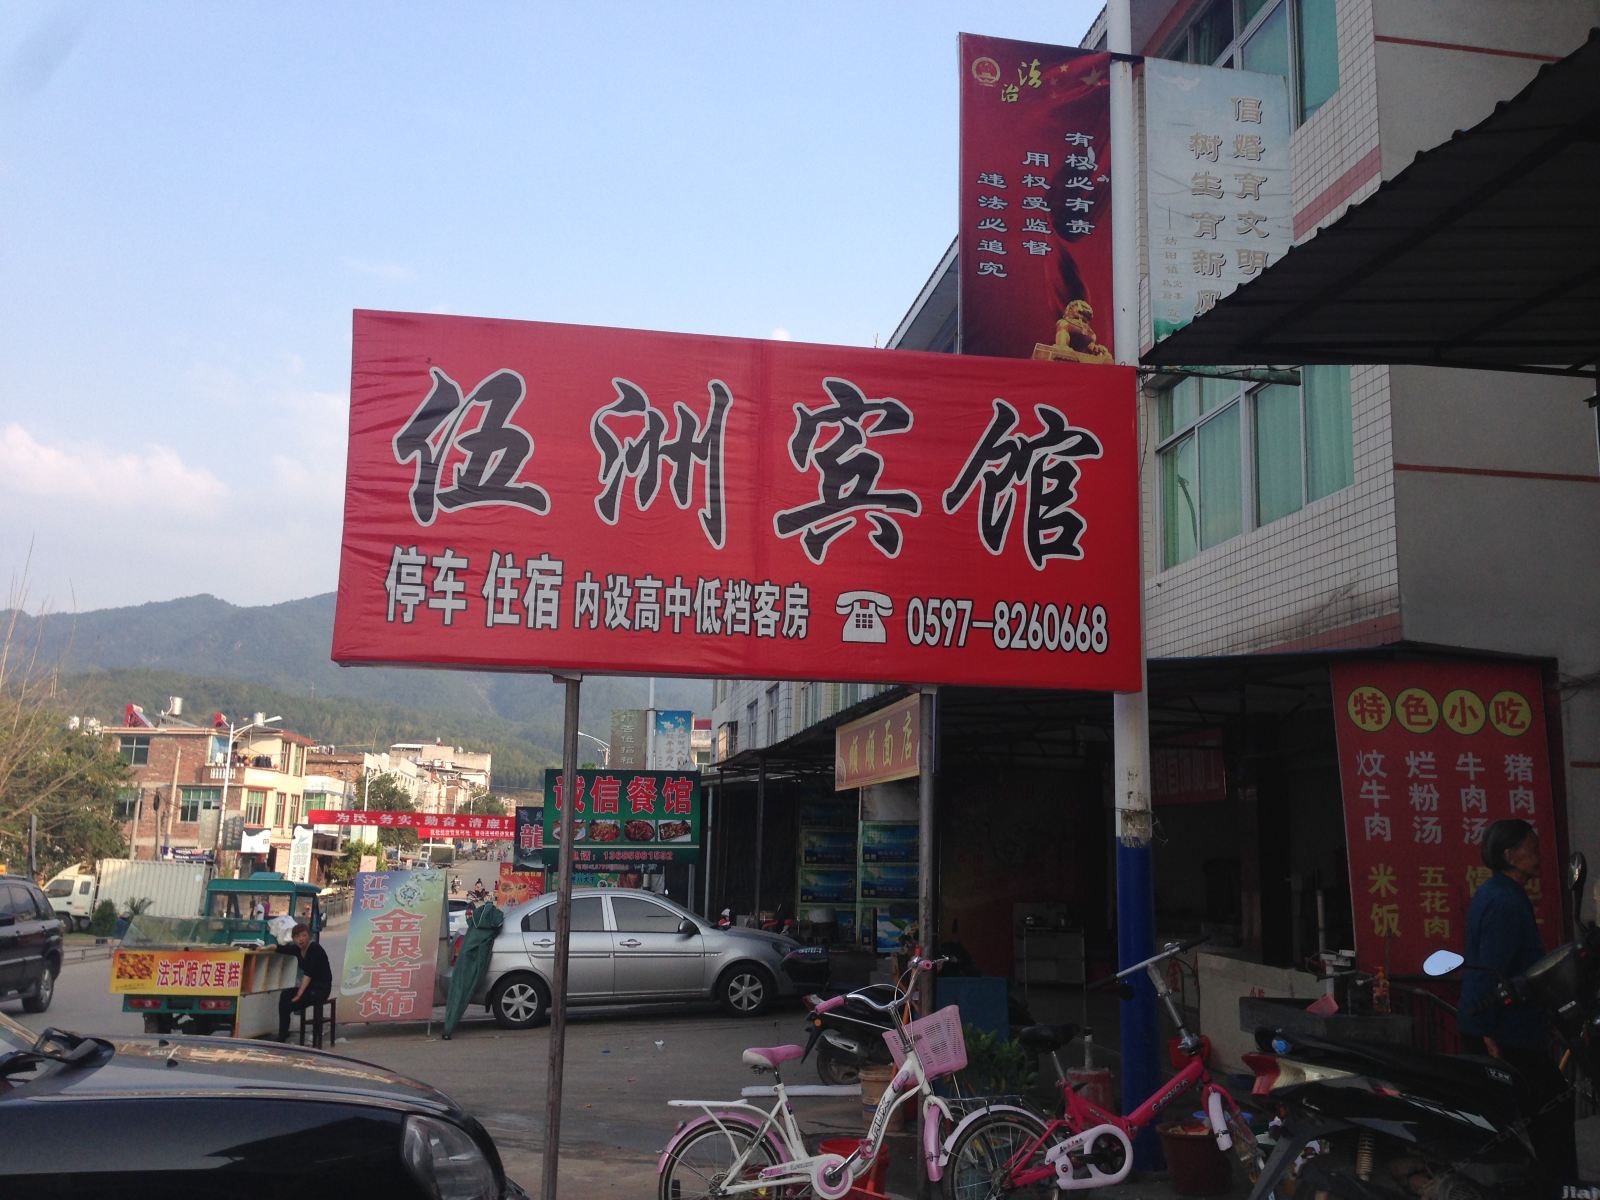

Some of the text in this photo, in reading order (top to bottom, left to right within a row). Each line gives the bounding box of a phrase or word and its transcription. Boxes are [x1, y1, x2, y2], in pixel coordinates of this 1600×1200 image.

[976, 172, 1008, 278] 违法必追究
[1022, 151, 1052, 256] 用权受监督
[1065, 132, 1096, 235] 有权必有责
[1189, 131, 1225, 318] 树生育新风
[391, 366, 1103, 571] 伍洲宾馆
[385, 545, 1109, 654] 停车 住宿 内设高中低档客房 0597-8260668
[1352, 691, 1527, 731] 特色小吃
[1404, 750, 1443, 844] 烂粉汤
[1504, 753, 1537, 834] 猪肉
[361, 874, 389, 910] 江记
[1368, 863, 1402, 938] 米饭
[1419, 867, 1451, 939] 五花肉
[157, 959, 241, 988] 法式脆皮蛋糕
[357, 908, 426, 1018] 金银首饰
